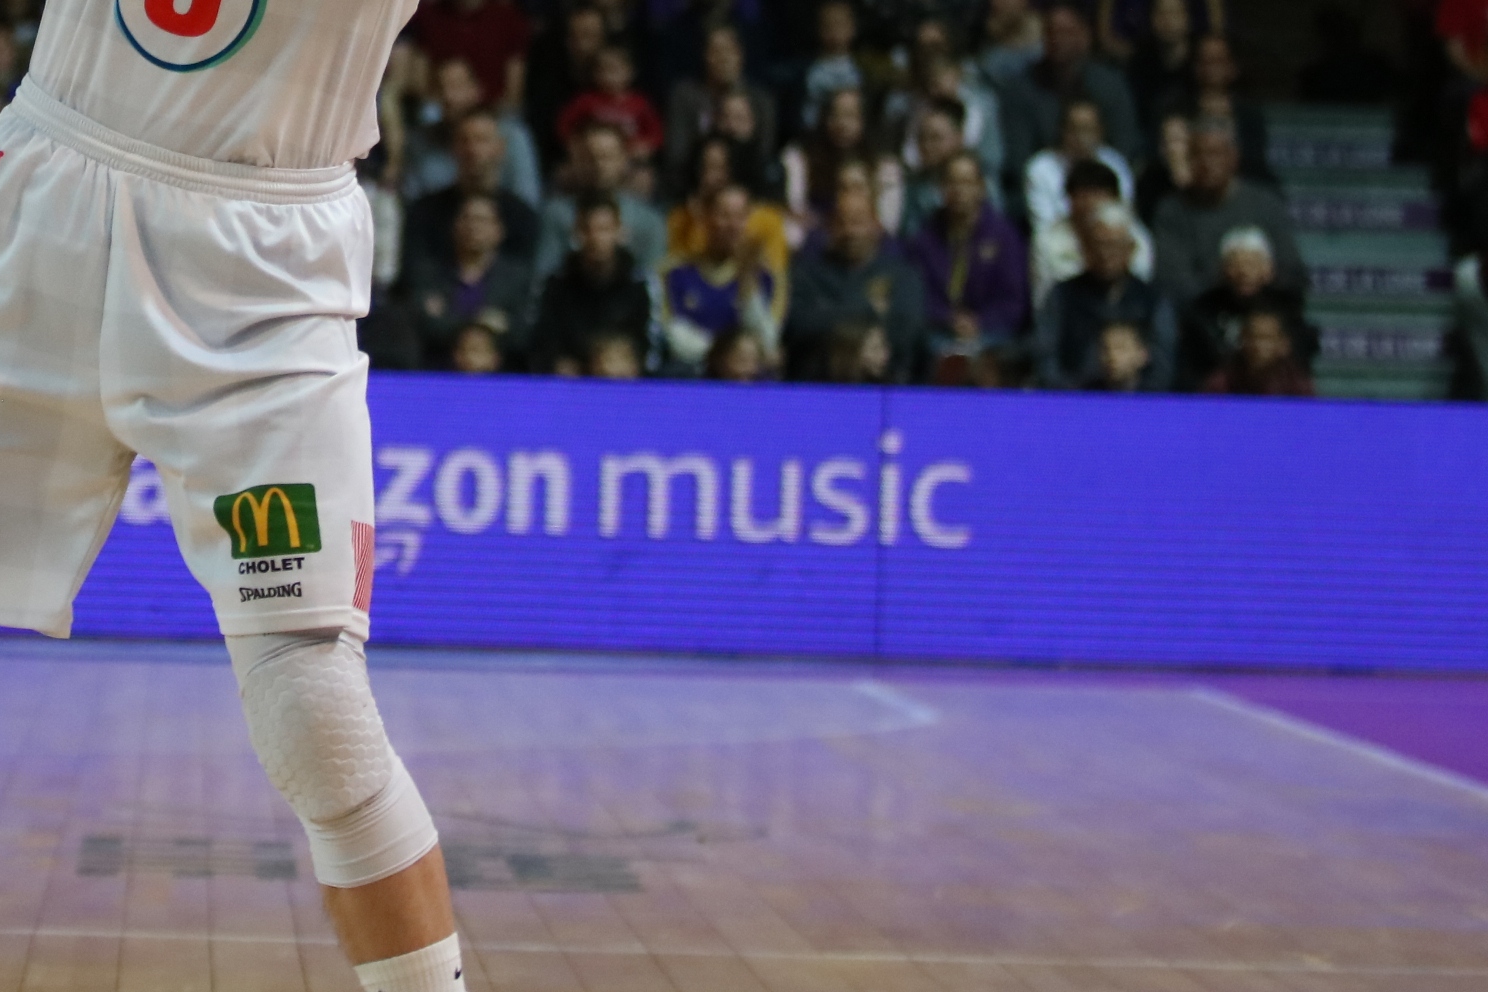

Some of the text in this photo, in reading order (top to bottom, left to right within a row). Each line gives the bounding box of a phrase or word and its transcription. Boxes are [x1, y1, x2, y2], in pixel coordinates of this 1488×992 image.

[596, 427, 974, 550] music
[238, 557, 305, 575] CHOLET
[239, 581, 302, 603] SPALDING
